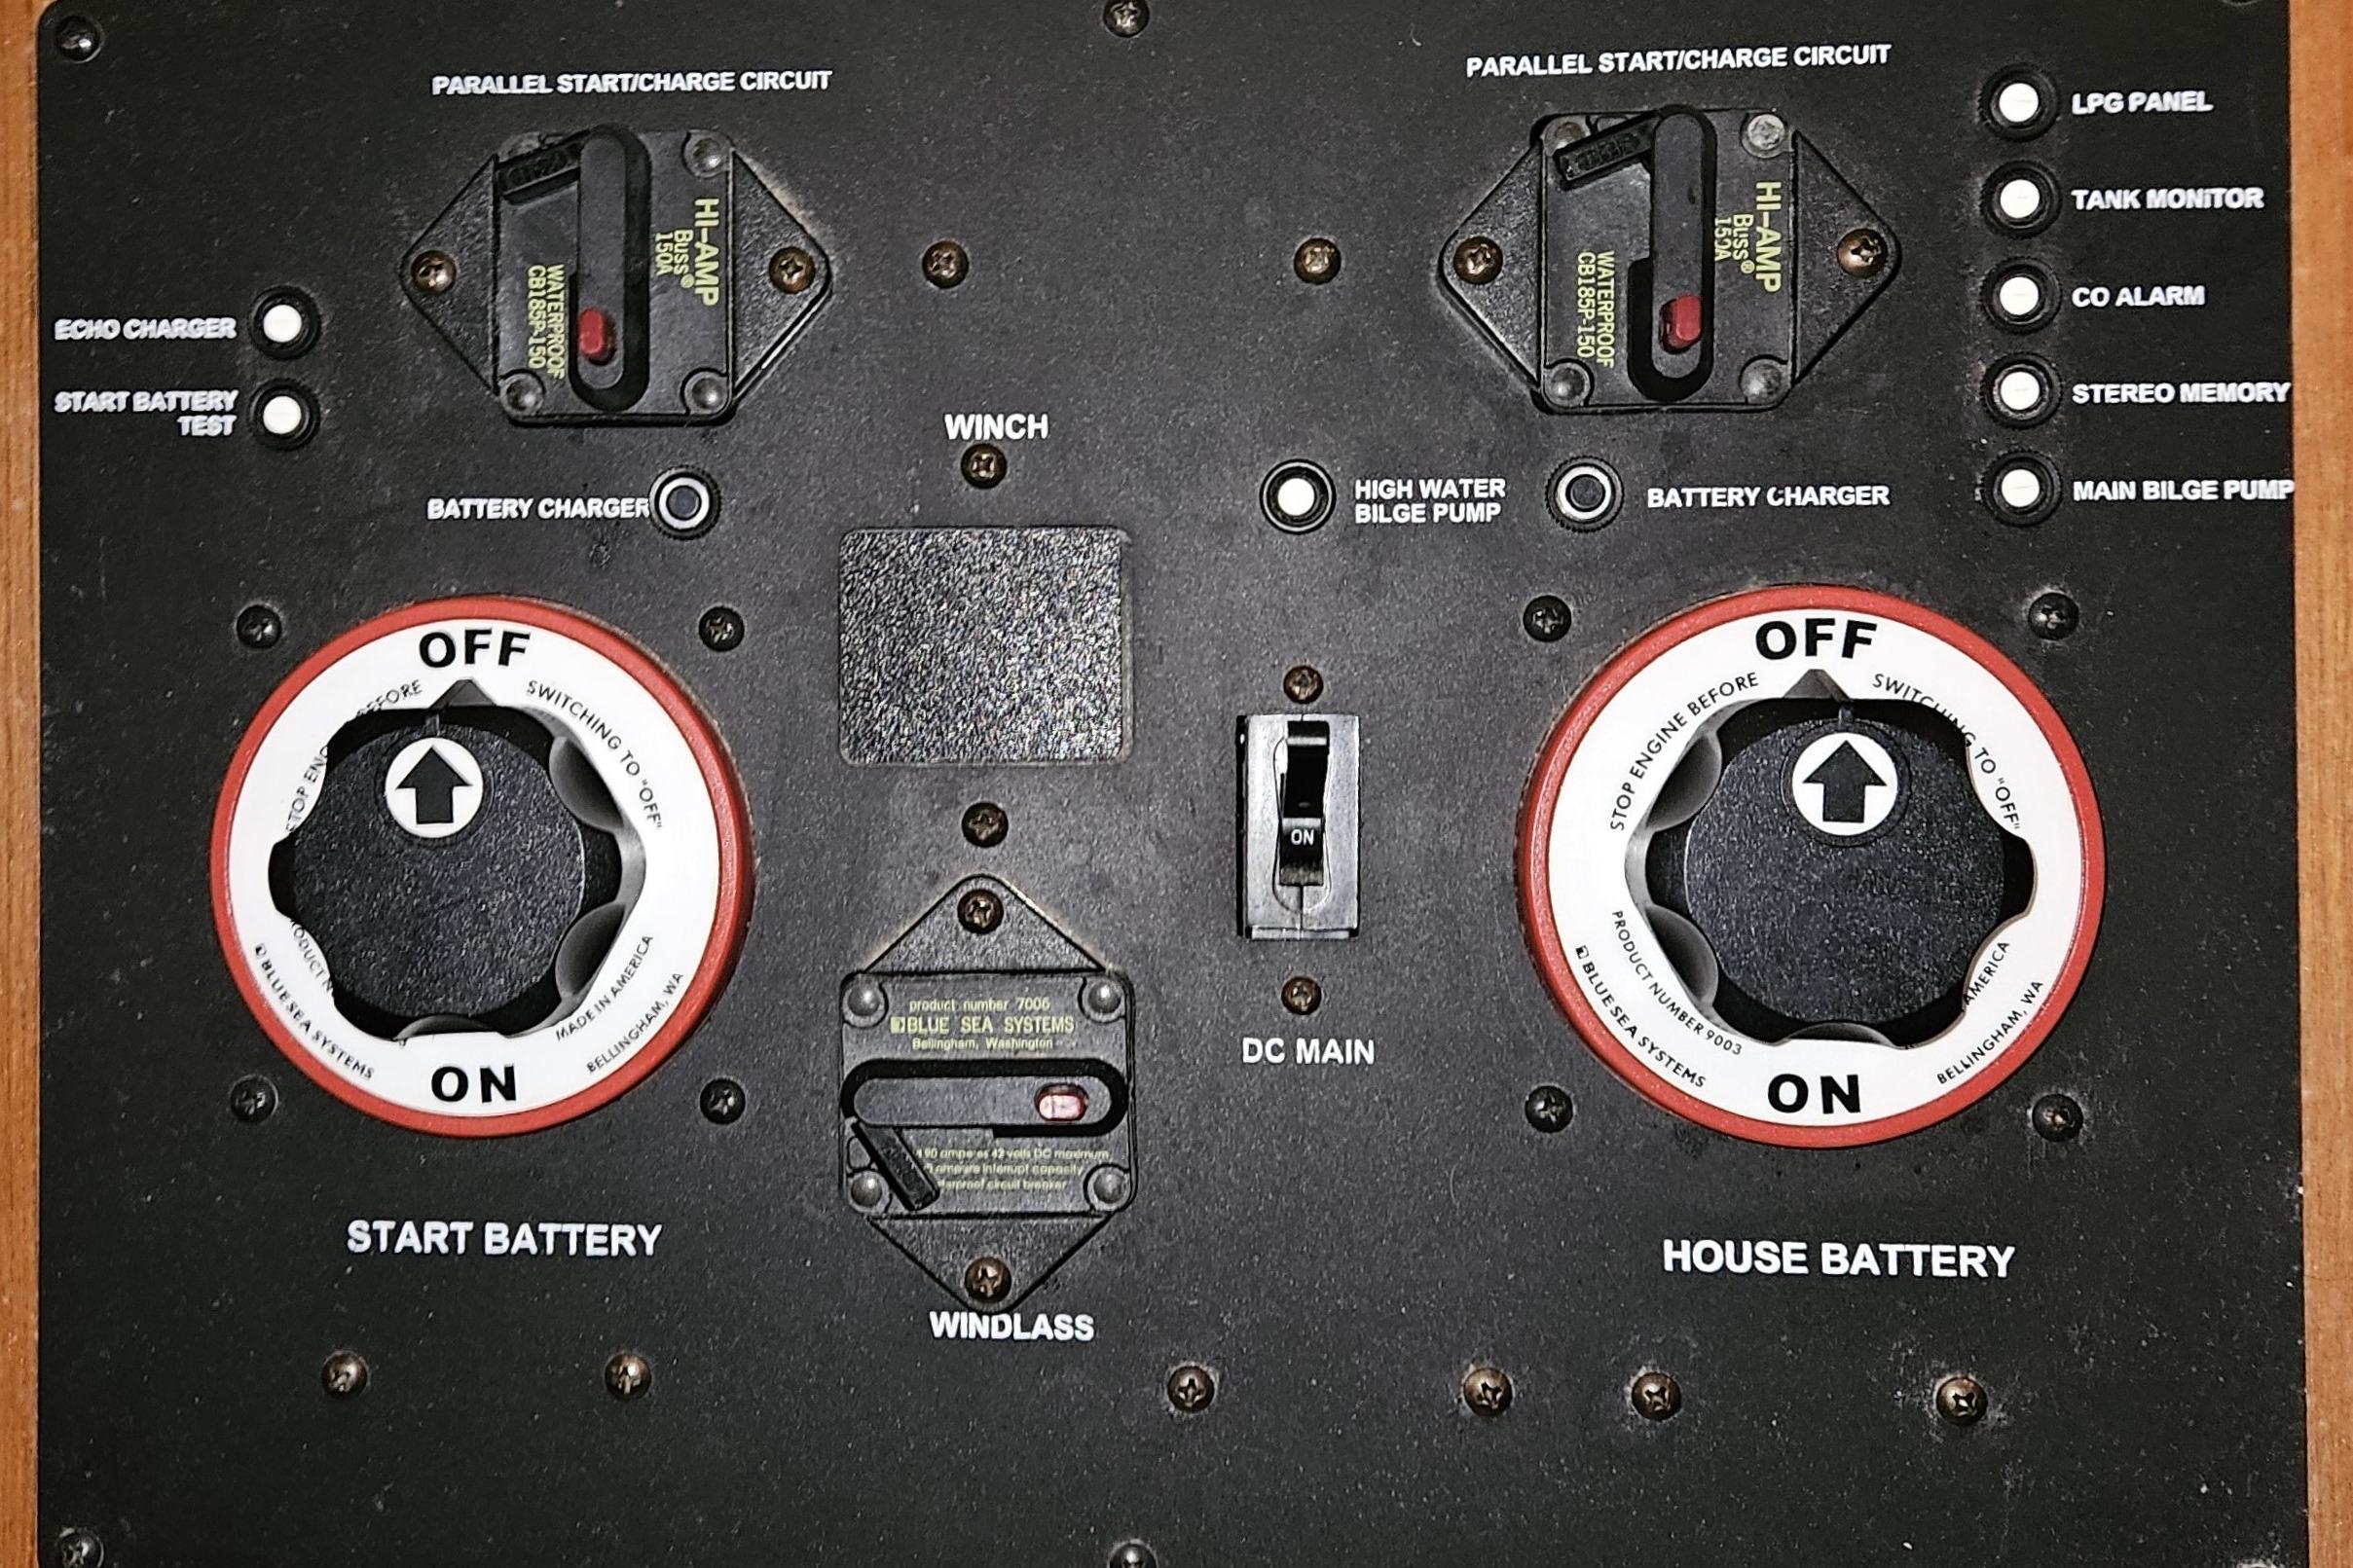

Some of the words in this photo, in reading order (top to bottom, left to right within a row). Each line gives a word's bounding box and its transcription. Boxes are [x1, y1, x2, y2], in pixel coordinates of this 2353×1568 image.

[1466, 55, 1593, 78] PARALLEL
[1598, 47, 1788, 74] START/CHARGE
[1793, 43, 1893, 66] CIRCUIT
[431, 75, 553, 95] PARALLEL
[556, 71, 736, 93] START/CHARGE
[739, 70, 833, 91] CIRCUIT
[2072, 92, 2124, 115] LPG
[2128, 91, 2214, 113] PANEL
[2071, 189, 2142, 210] TANK
[2146, 188, 2265, 209] MONITOR
[655, 232, 674, 276] 150A
[1714, 217, 1732, 262] 150A
[1576, 251, 1597, 358] CB185P-150
[1597, 250, 1615, 369] WATERPROOF
[2072, 287, 2111, 308] CO
[2114, 285, 2206, 307] ALARM
[55, 318, 121, 341] ECHO
[123, 317, 238, 340] CHARGER
[528, 265, 546, 370] CB185P-150
[546, 264, 565, 380] WATERPROOF
[55, 391, 130, 413] START
[132, 389, 239, 412] BATTERY
[2072, 383, 2176, 405] STEREO
[2179, 383, 2292, 403] MEMORY
[177, 415, 238, 436] TEST
[943, 413, 1049, 441] WINCH
[1354, 479, 1414, 501] HIGH
[1418, 477, 1507, 498] WATER
[1646, 486, 1759, 509] BATTERY
[1765, 485, 1892, 507] CHARGER
[2073, 481, 2137, 501] MAIN
[2143, 480, 2220, 500] BILGE
[2224, 480, 2296, 500] PUMP
[426, 496, 535, 520] BATTERY
[536, 496, 650, 519] CHARGER
[1354, 502, 1427, 524] BILGE
[1432, 502, 1502, 524] PUMP
[419, 628, 532, 669] OFF
[1755, 617, 1878, 661] OFF
[526, 679, 622, 751] SWITCHING
[619, 749, 642, 778] TO
[1609, 781, 1637, 832] STOP
[1629, 711, 1689, 780] ENGINE
[1686, 671, 1760, 717] BEFORE
[1973, 747, 1997, 775] TO
[1290, 828, 1315, 846] ON
[555, 1012, 596, 1041] MADE
[594, 997, 612, 1015] IN
[610, 934, 654, 999] AMERICA
[1611, 910, 1653, 987] PRODUCT
[1648, 982, 1705, 1037] NUMBER
[1706, 1029, 1744, 1057] 9003
[261, 958, 290, 1003] BLUE
[285, 1002, 313, 1034] SEA
[311, 1028, 376, 1080] SYSTEMS
[908, 998, 956, 1013] product
[963, 998, 1010, 1011] number
[585, 1001, 671, 1075] BELLINGHAM,
[662, 971, 685, 997] WA
[906, 1015, 950, 1035] BLUE
[960, 1015, 994, 1035] SEA
[1004, 1015, 1075, 1035] SYSTEMS
[1581, 960, 1617, 1008] BLUE
[1608, 1003, 1637, 1039] SEA
[1637, 1034, 1707, 1089] SYSTEMS
[1936, 1008, 2029, 1085] BELLINGHAM,
[2019, 980, 2044, 1006] WA
[985, 1037, 1053, 1051] Washington
[1241, 1037, 1286, 1065] DC
[1295, 1037, 1376, 1066] MAIN
[431, 1063, 517, 1104] ON
[1767, 1073, 1861, 1115] ON
[1007, 1148, 1031, 1159] volts
[1033, 1148, 1052, 1159] DC
[986, 1178, 1021, 1190] circuit
[1023, 1179, 1068, 1190] breaker
[1032, 1163, 1084, 1177] capacity
[346, 1219, 474, 1256] START
[484, 1222, 663, 1258] BATTERY
[1663, 1239, 1810, 1275] HOUSE
[1820, 1242, 2016, 1279] BATTERY
[929, 1310, 1095, 1341] WINDLASS
